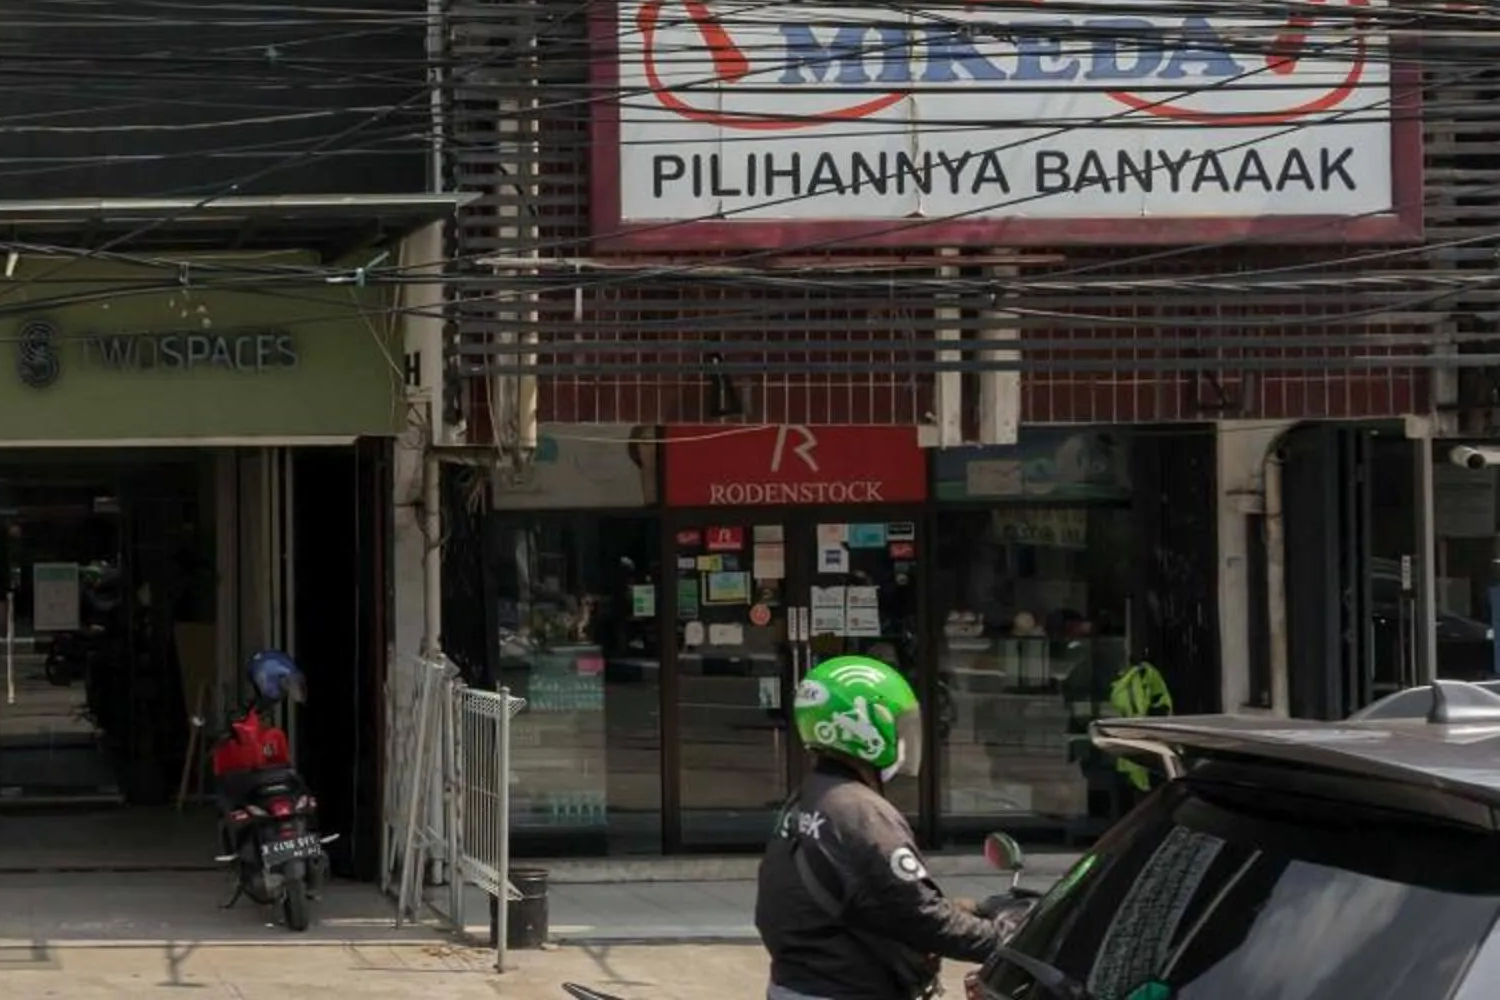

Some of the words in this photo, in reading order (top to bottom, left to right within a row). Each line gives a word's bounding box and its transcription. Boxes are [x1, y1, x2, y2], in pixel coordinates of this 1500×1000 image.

[777, 13, 1245, 85] MIKEDA
[653, 150, 1011, 199] PILIHANNYA
[1034, 147, 1357, 195] BANYAAAK
[80, 334, 299, 370] TWOSPACES
[708, 480, 884, 505] RODENSTOCK
